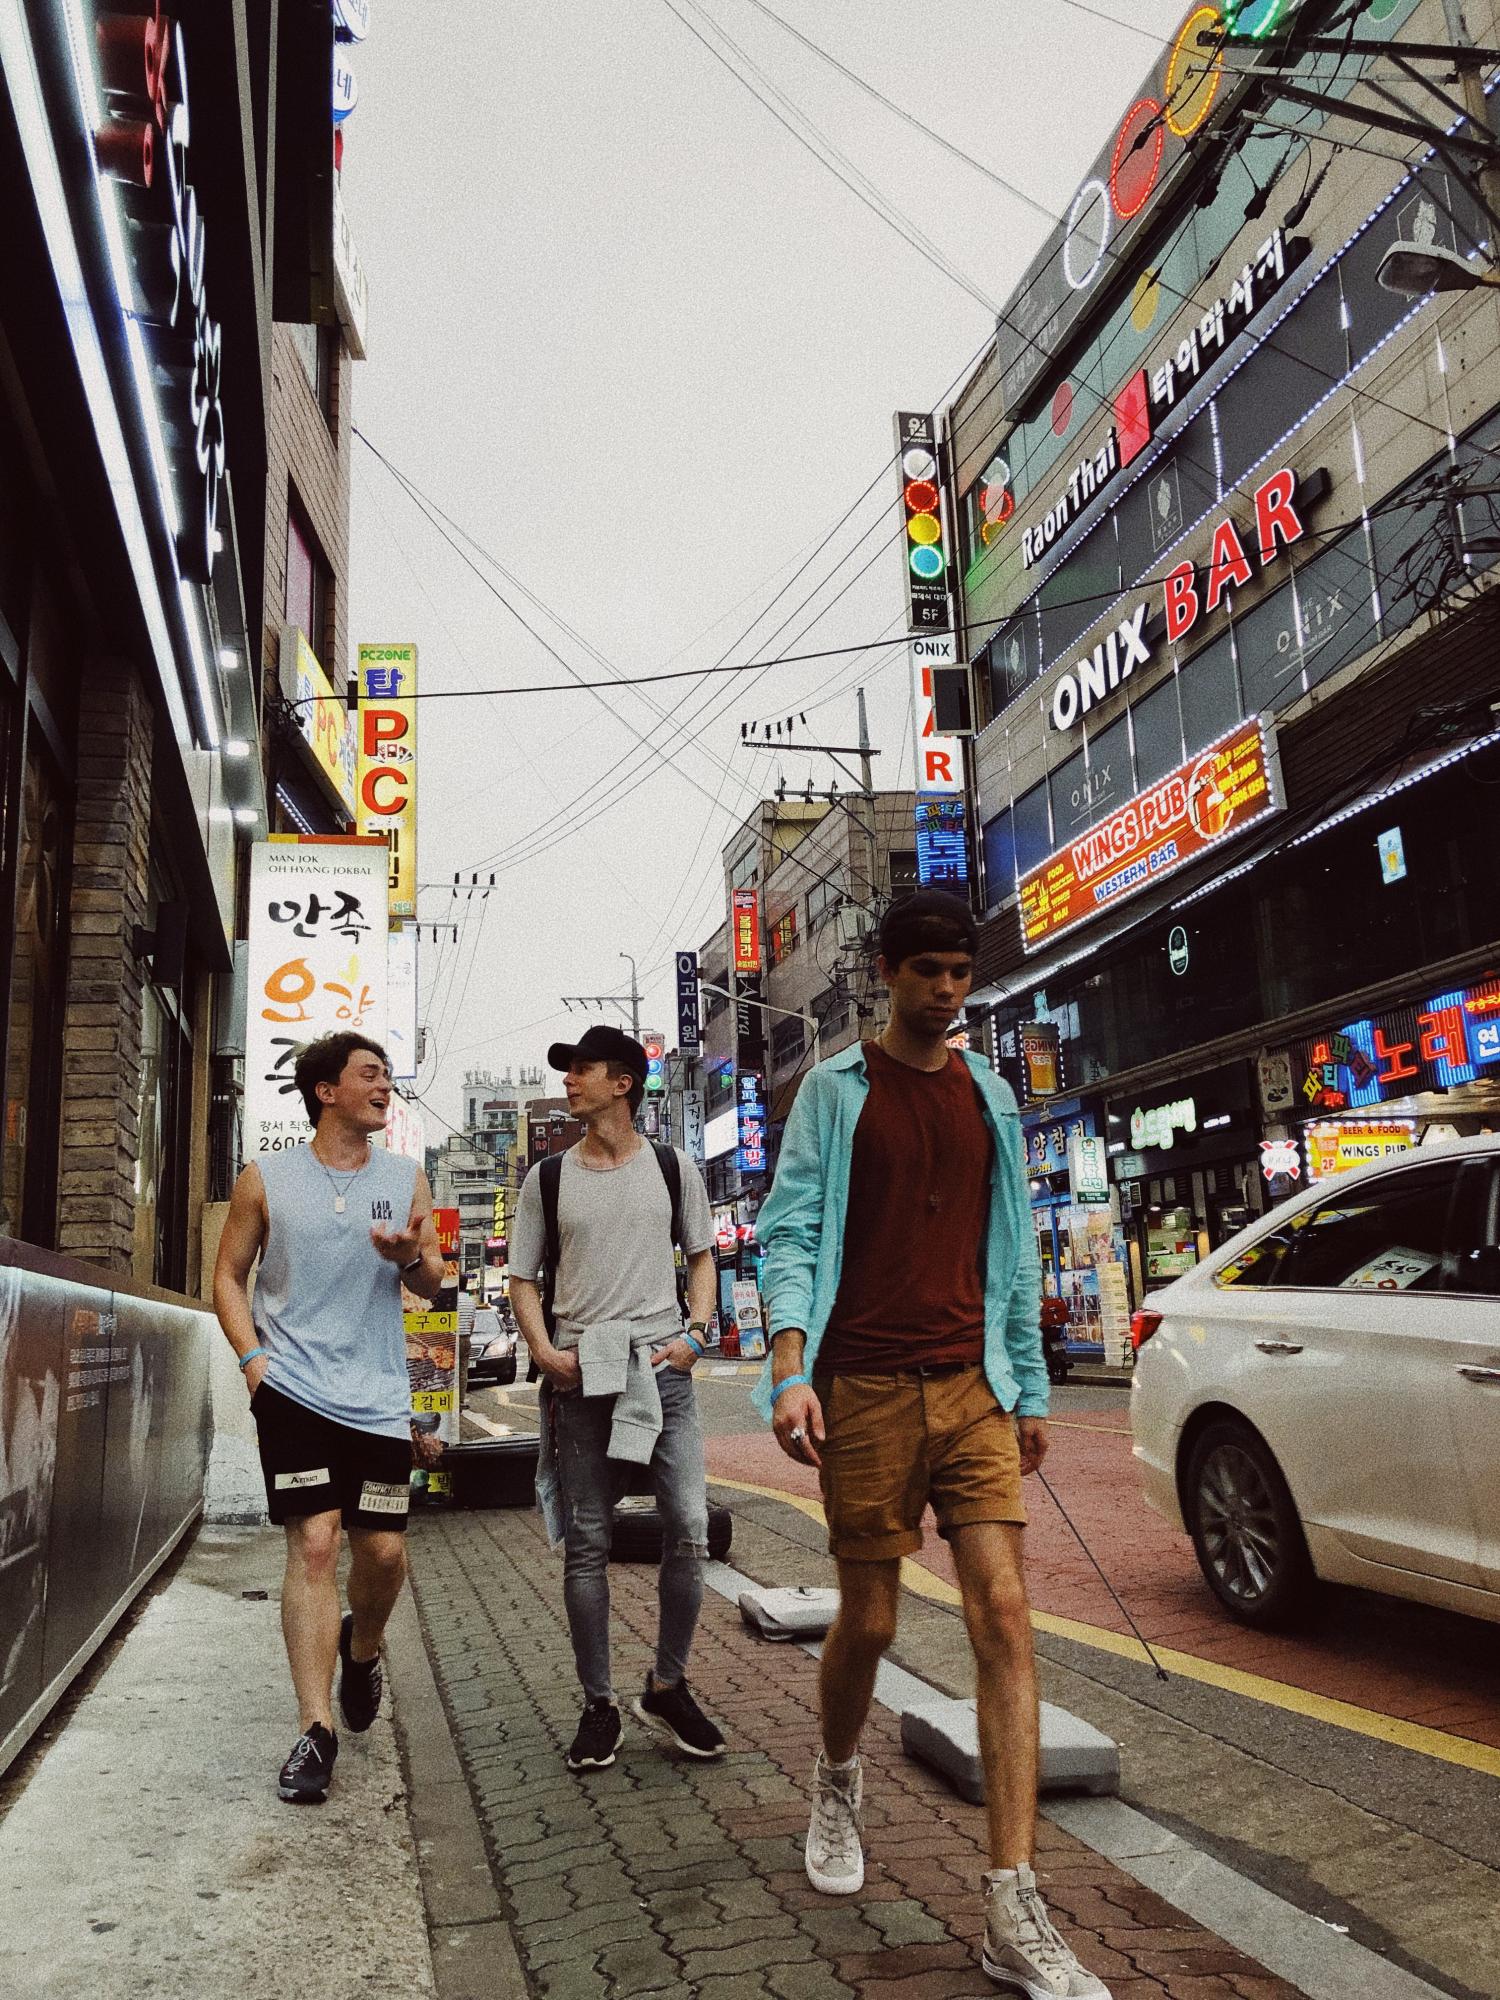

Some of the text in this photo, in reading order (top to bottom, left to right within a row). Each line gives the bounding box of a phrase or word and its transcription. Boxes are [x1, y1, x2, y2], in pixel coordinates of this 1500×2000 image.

[1153, 227, 1285, 404] 타이마사지
[1021, 427, 1117, 569] Raon Thai
[1052, 468, 1303, 731] ONIX BAR
[922, 609, 938, 621] 5F
[361, 650, 411, 661] PCZONE
[914, 641, 950, 657] ONIX
[367, 669, 403, 699] 탑
[1214, 750, 1232, 773] TAP
[1072, 777, 1188, 881] WINGS PUB
[268, 855, 319, 863] MAN JOK
[268, 865, 287, 873] OH
[290, 866, 330, 874] HYANG
[1093, 859, 1148, 903] WESTERN
[1149, 841, 1178, 871] BAR
[268, 890, 371, 944] 만족
[261, 957, 375, 1026] 오향
[680, 981, 698, 1043] 고시원
[260, 1120, 283, 1133] 강서
[1343, 1125, 1401, 1135] BEER & FOOD
[743, 1117, 761, 1167] 노래방
[1341, 1146, 1380, 1158] WINGS
[1322, 1159, 1335, 1171] 2F
[371, 1200, 390, 1210] LAID
[371, 1209, 393, 1220] BACK
